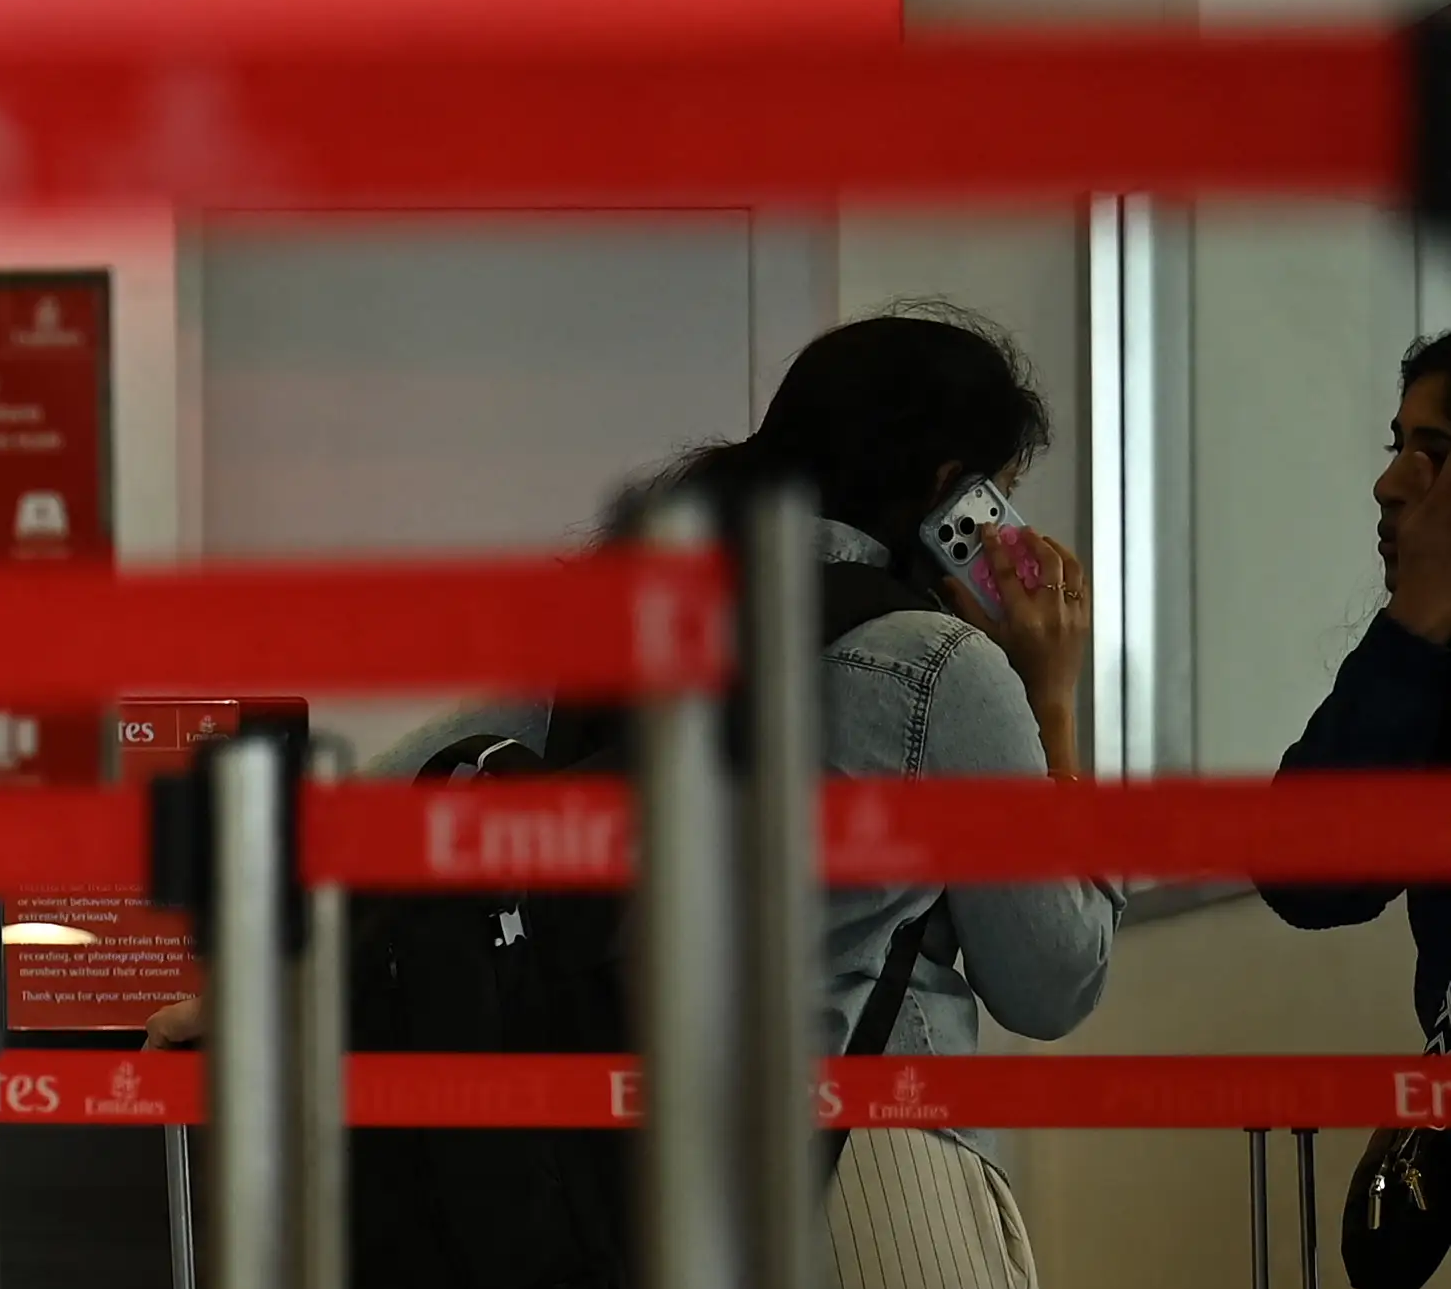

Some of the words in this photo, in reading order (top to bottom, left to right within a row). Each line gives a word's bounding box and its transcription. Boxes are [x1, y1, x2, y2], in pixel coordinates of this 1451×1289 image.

[155, 935, 180, 945] from
[22, 991, 50, 1001] Thank
[55, 993, 75, 1003] you
[96, 993, 118, 1003] your
[868, 1100, 949, 1121] Emirates
